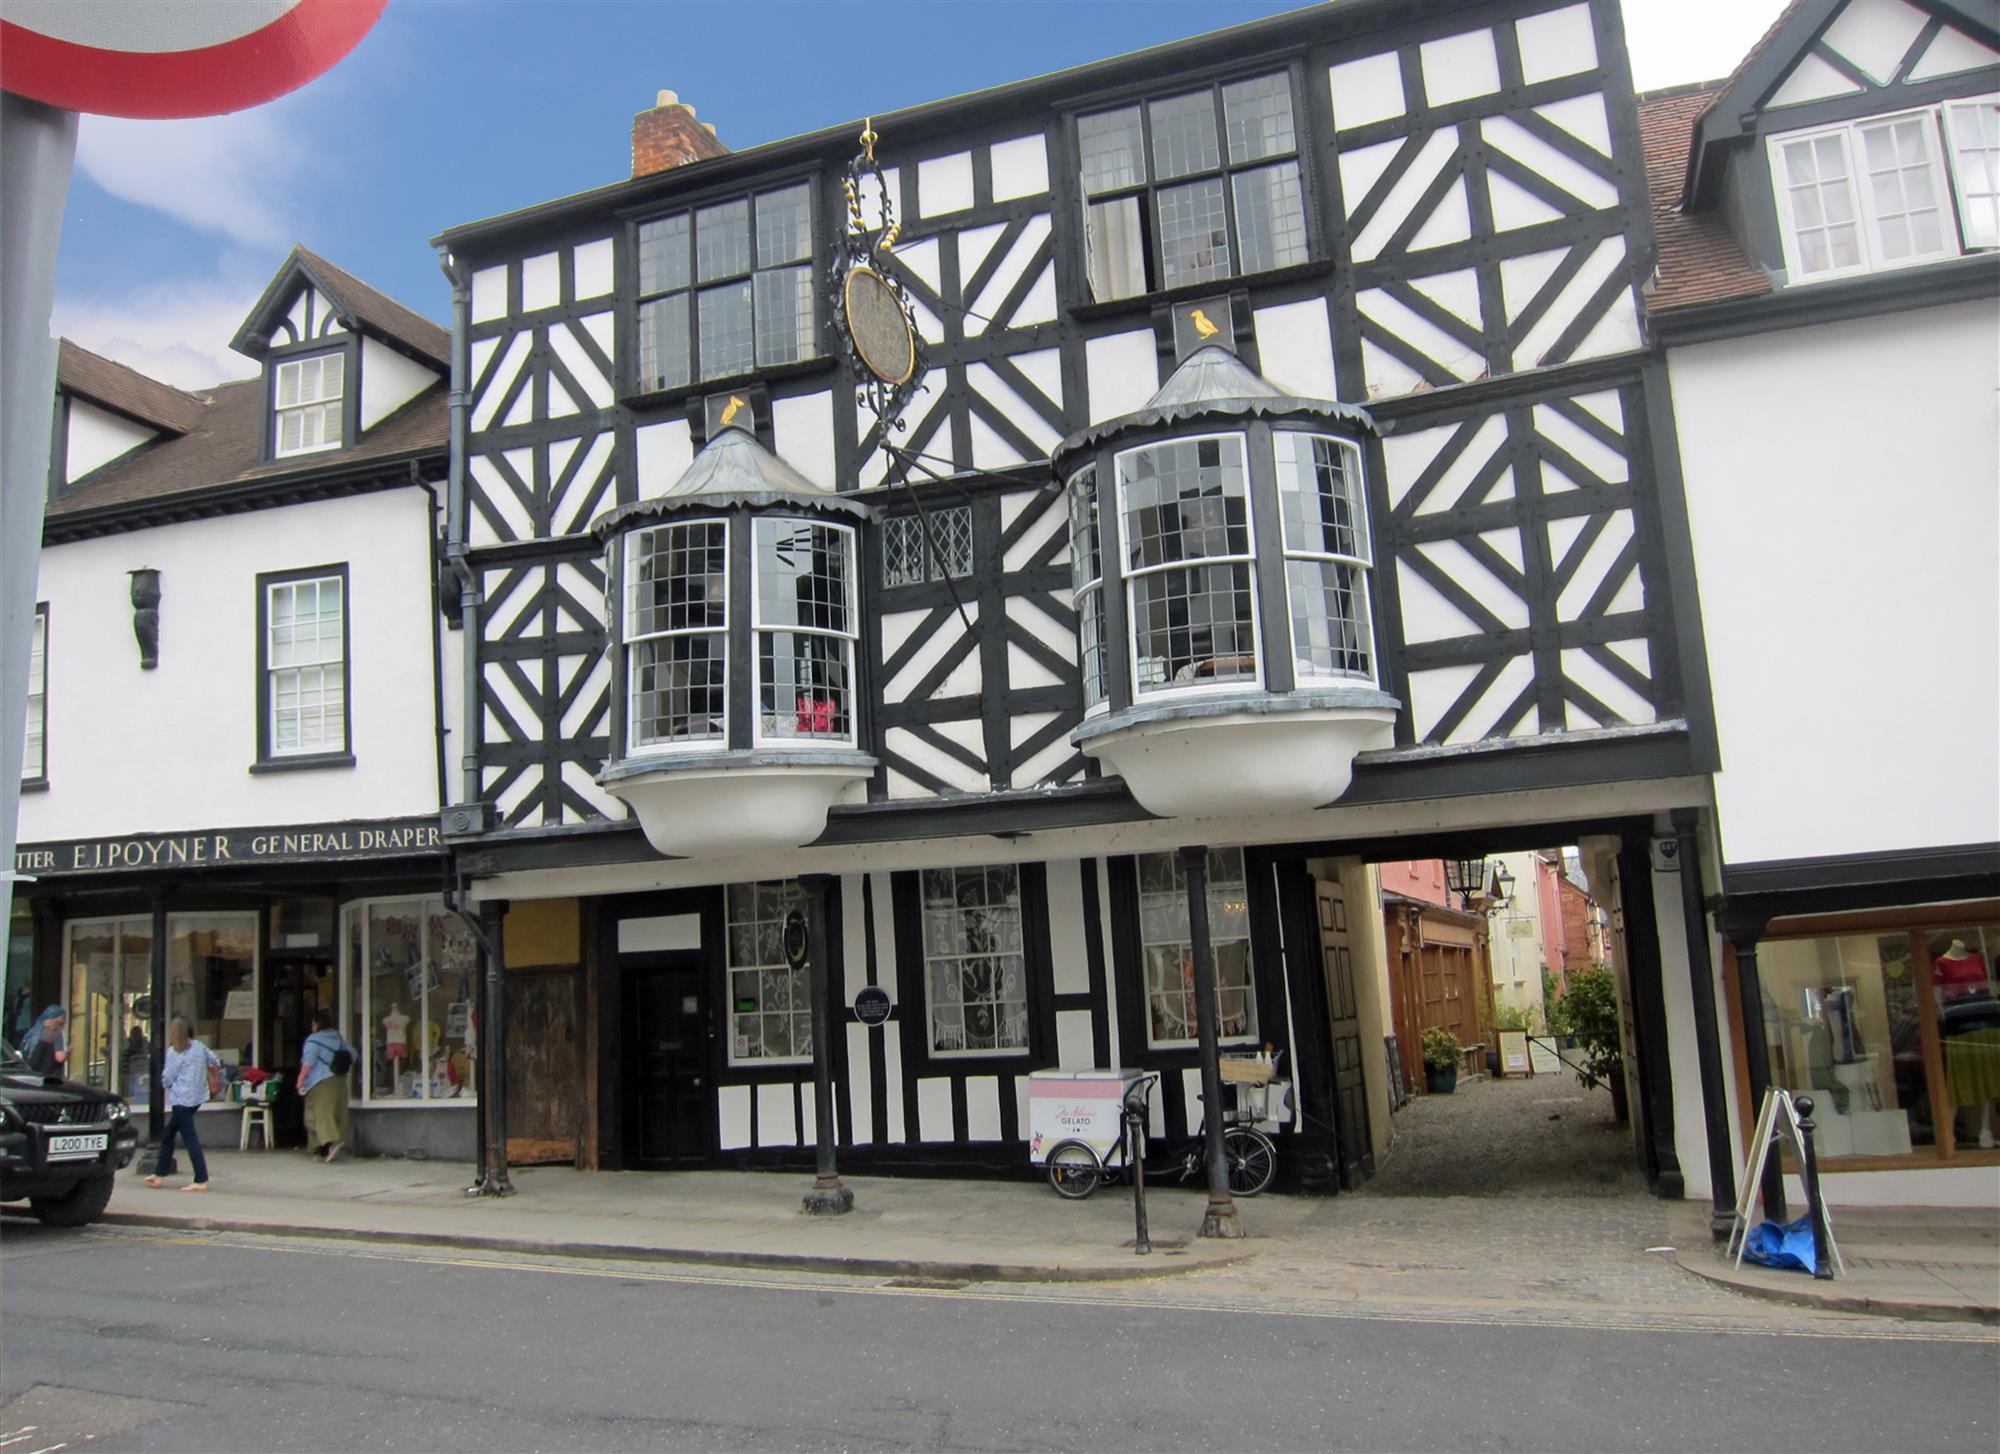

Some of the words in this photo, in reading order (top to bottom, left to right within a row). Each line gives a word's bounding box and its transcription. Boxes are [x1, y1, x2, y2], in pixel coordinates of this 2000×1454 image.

[252, 832, 353, 855] GENERAL
[359, 827, 443, 850] DRAPER
[54, 1138, 81, 1151] L200
[84, 1136, 103, 1149] TYE
